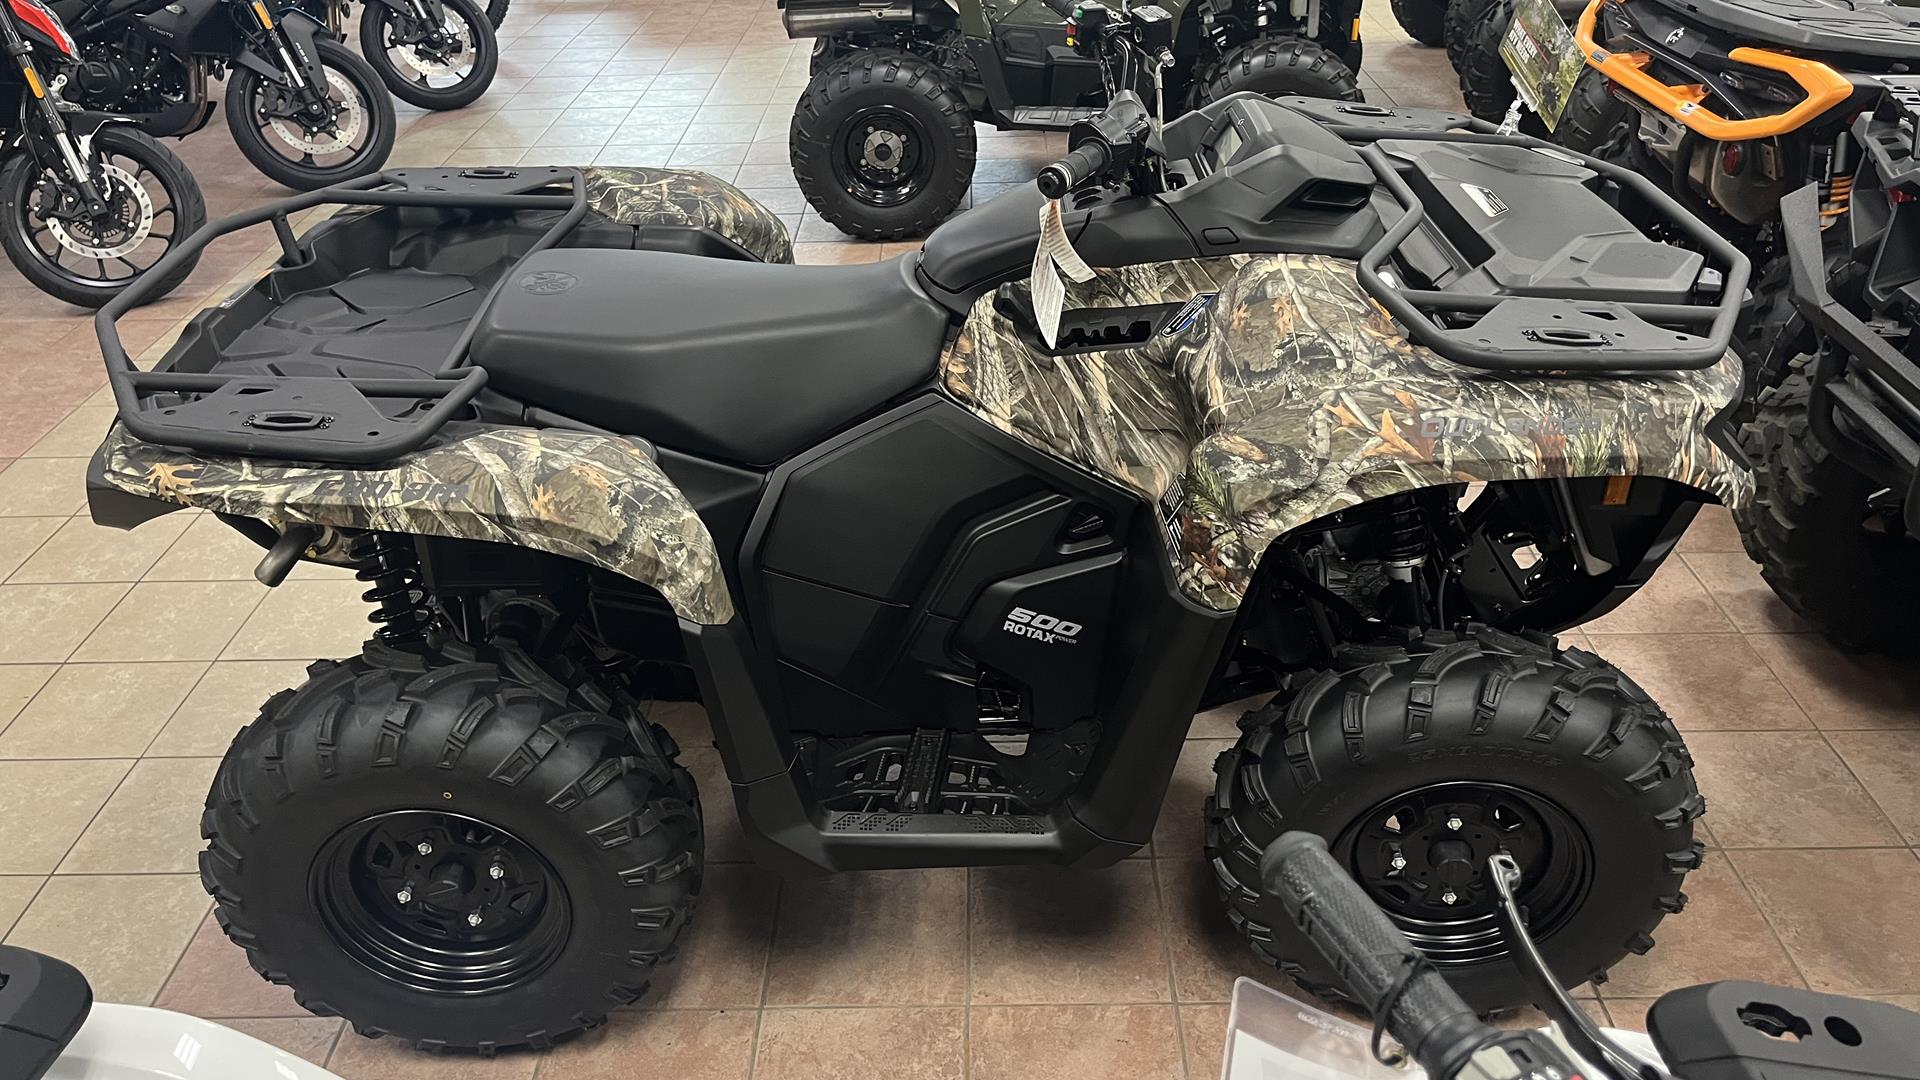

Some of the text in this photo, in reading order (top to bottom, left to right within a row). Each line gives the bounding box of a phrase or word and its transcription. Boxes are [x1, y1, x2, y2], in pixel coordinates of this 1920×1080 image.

[1003, 620, 1077, 644] ROTAX POWER
[1008, 607, 1082, 636] 500
